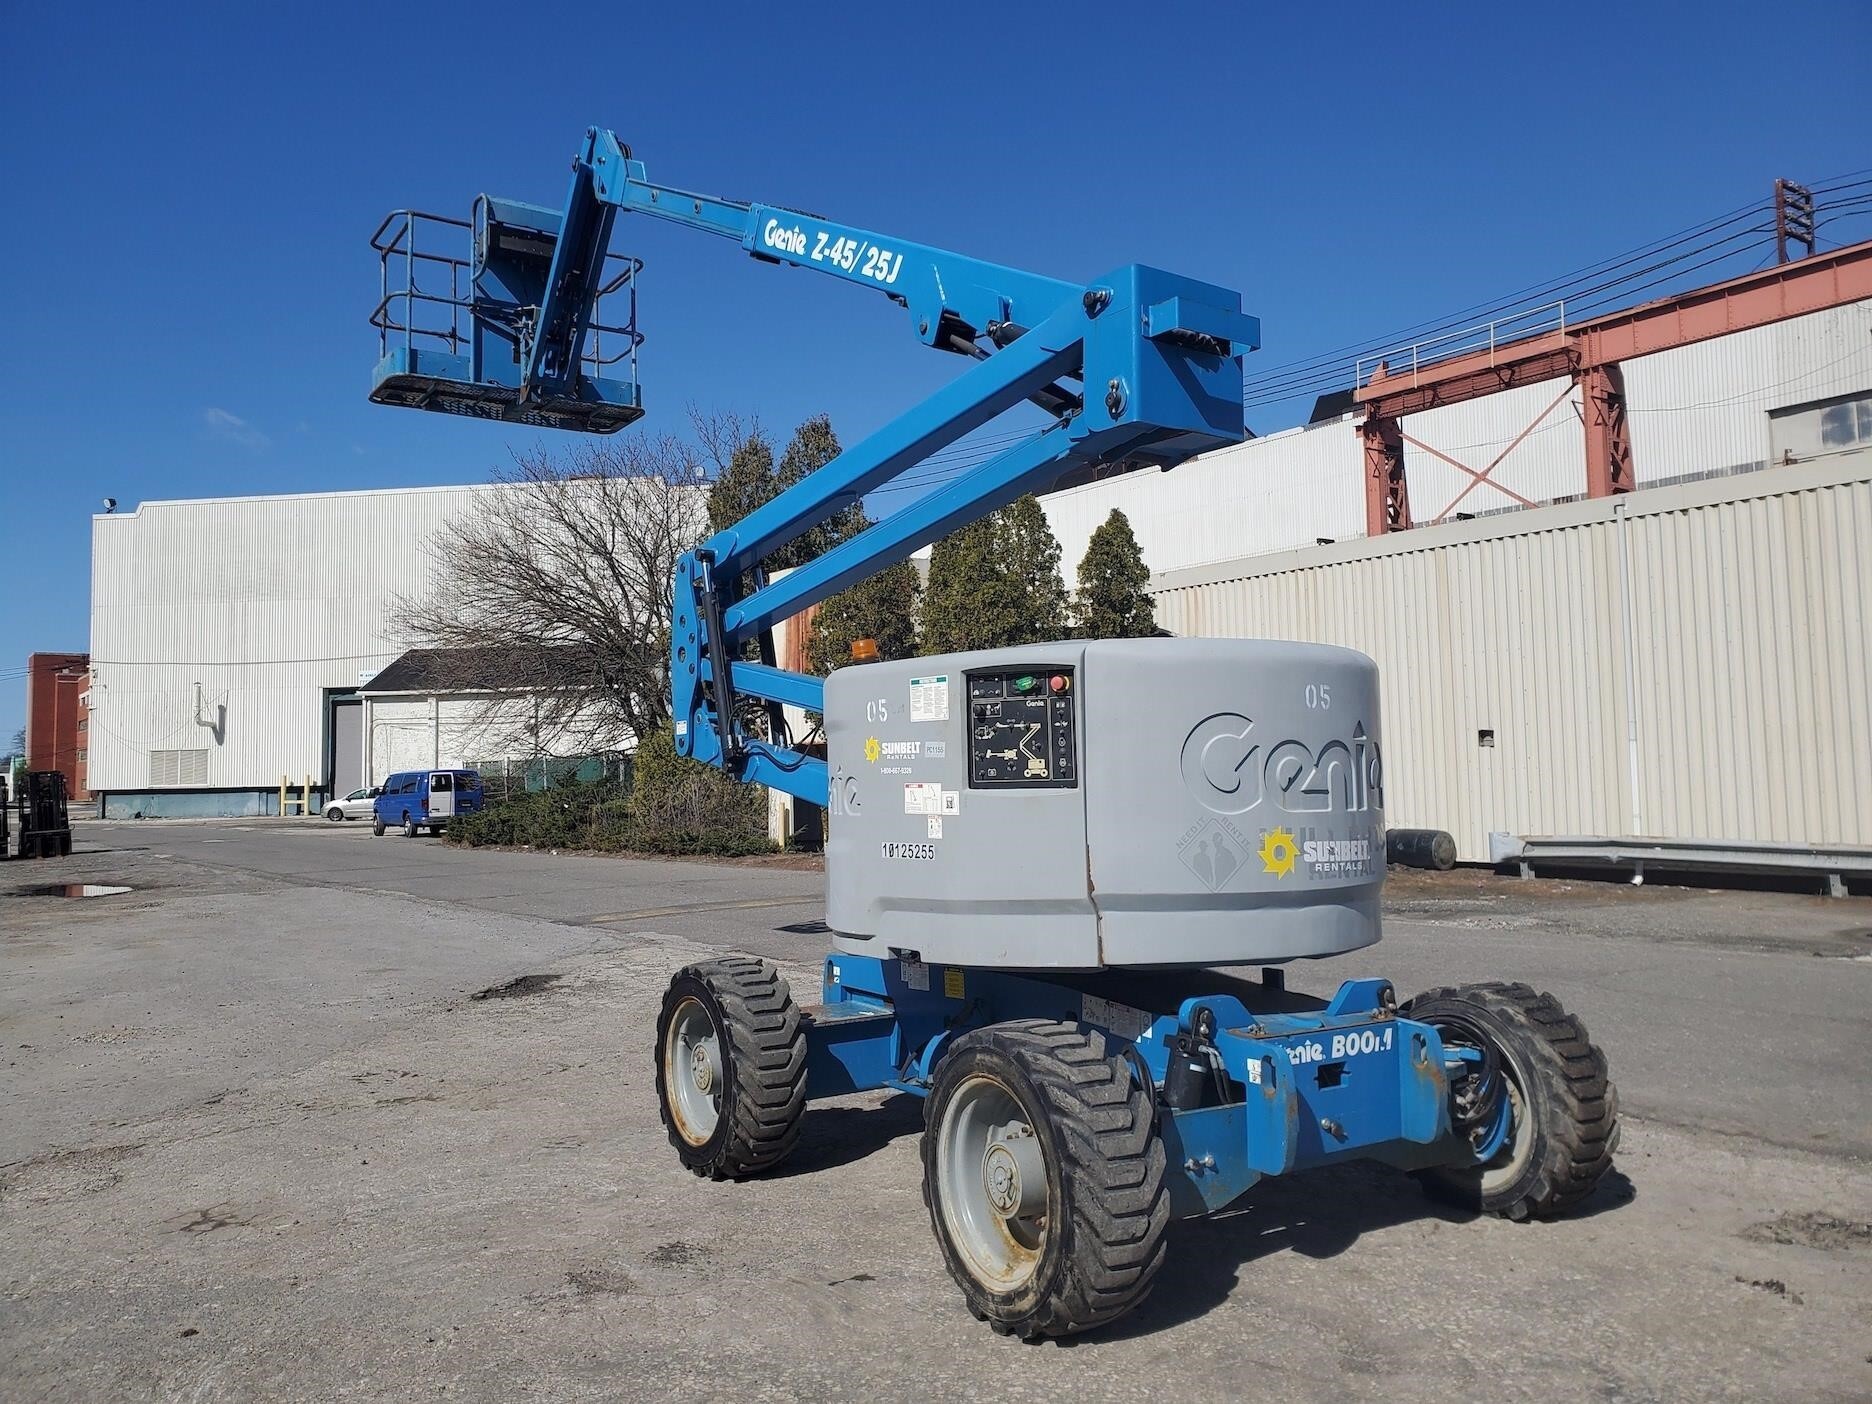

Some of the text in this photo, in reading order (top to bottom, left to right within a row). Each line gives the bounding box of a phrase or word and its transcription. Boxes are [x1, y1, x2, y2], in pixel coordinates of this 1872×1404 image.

[764, 218, 807, 255] Genie
[1305, 684, 1331, 709] 05
[866, 698, 888, 722] 05
[881, 741, 921, 755] SUNBELT
[1303, 840, 1370, 862] SUNBELT
[1315, 861, 1363, 872] RENTALS
